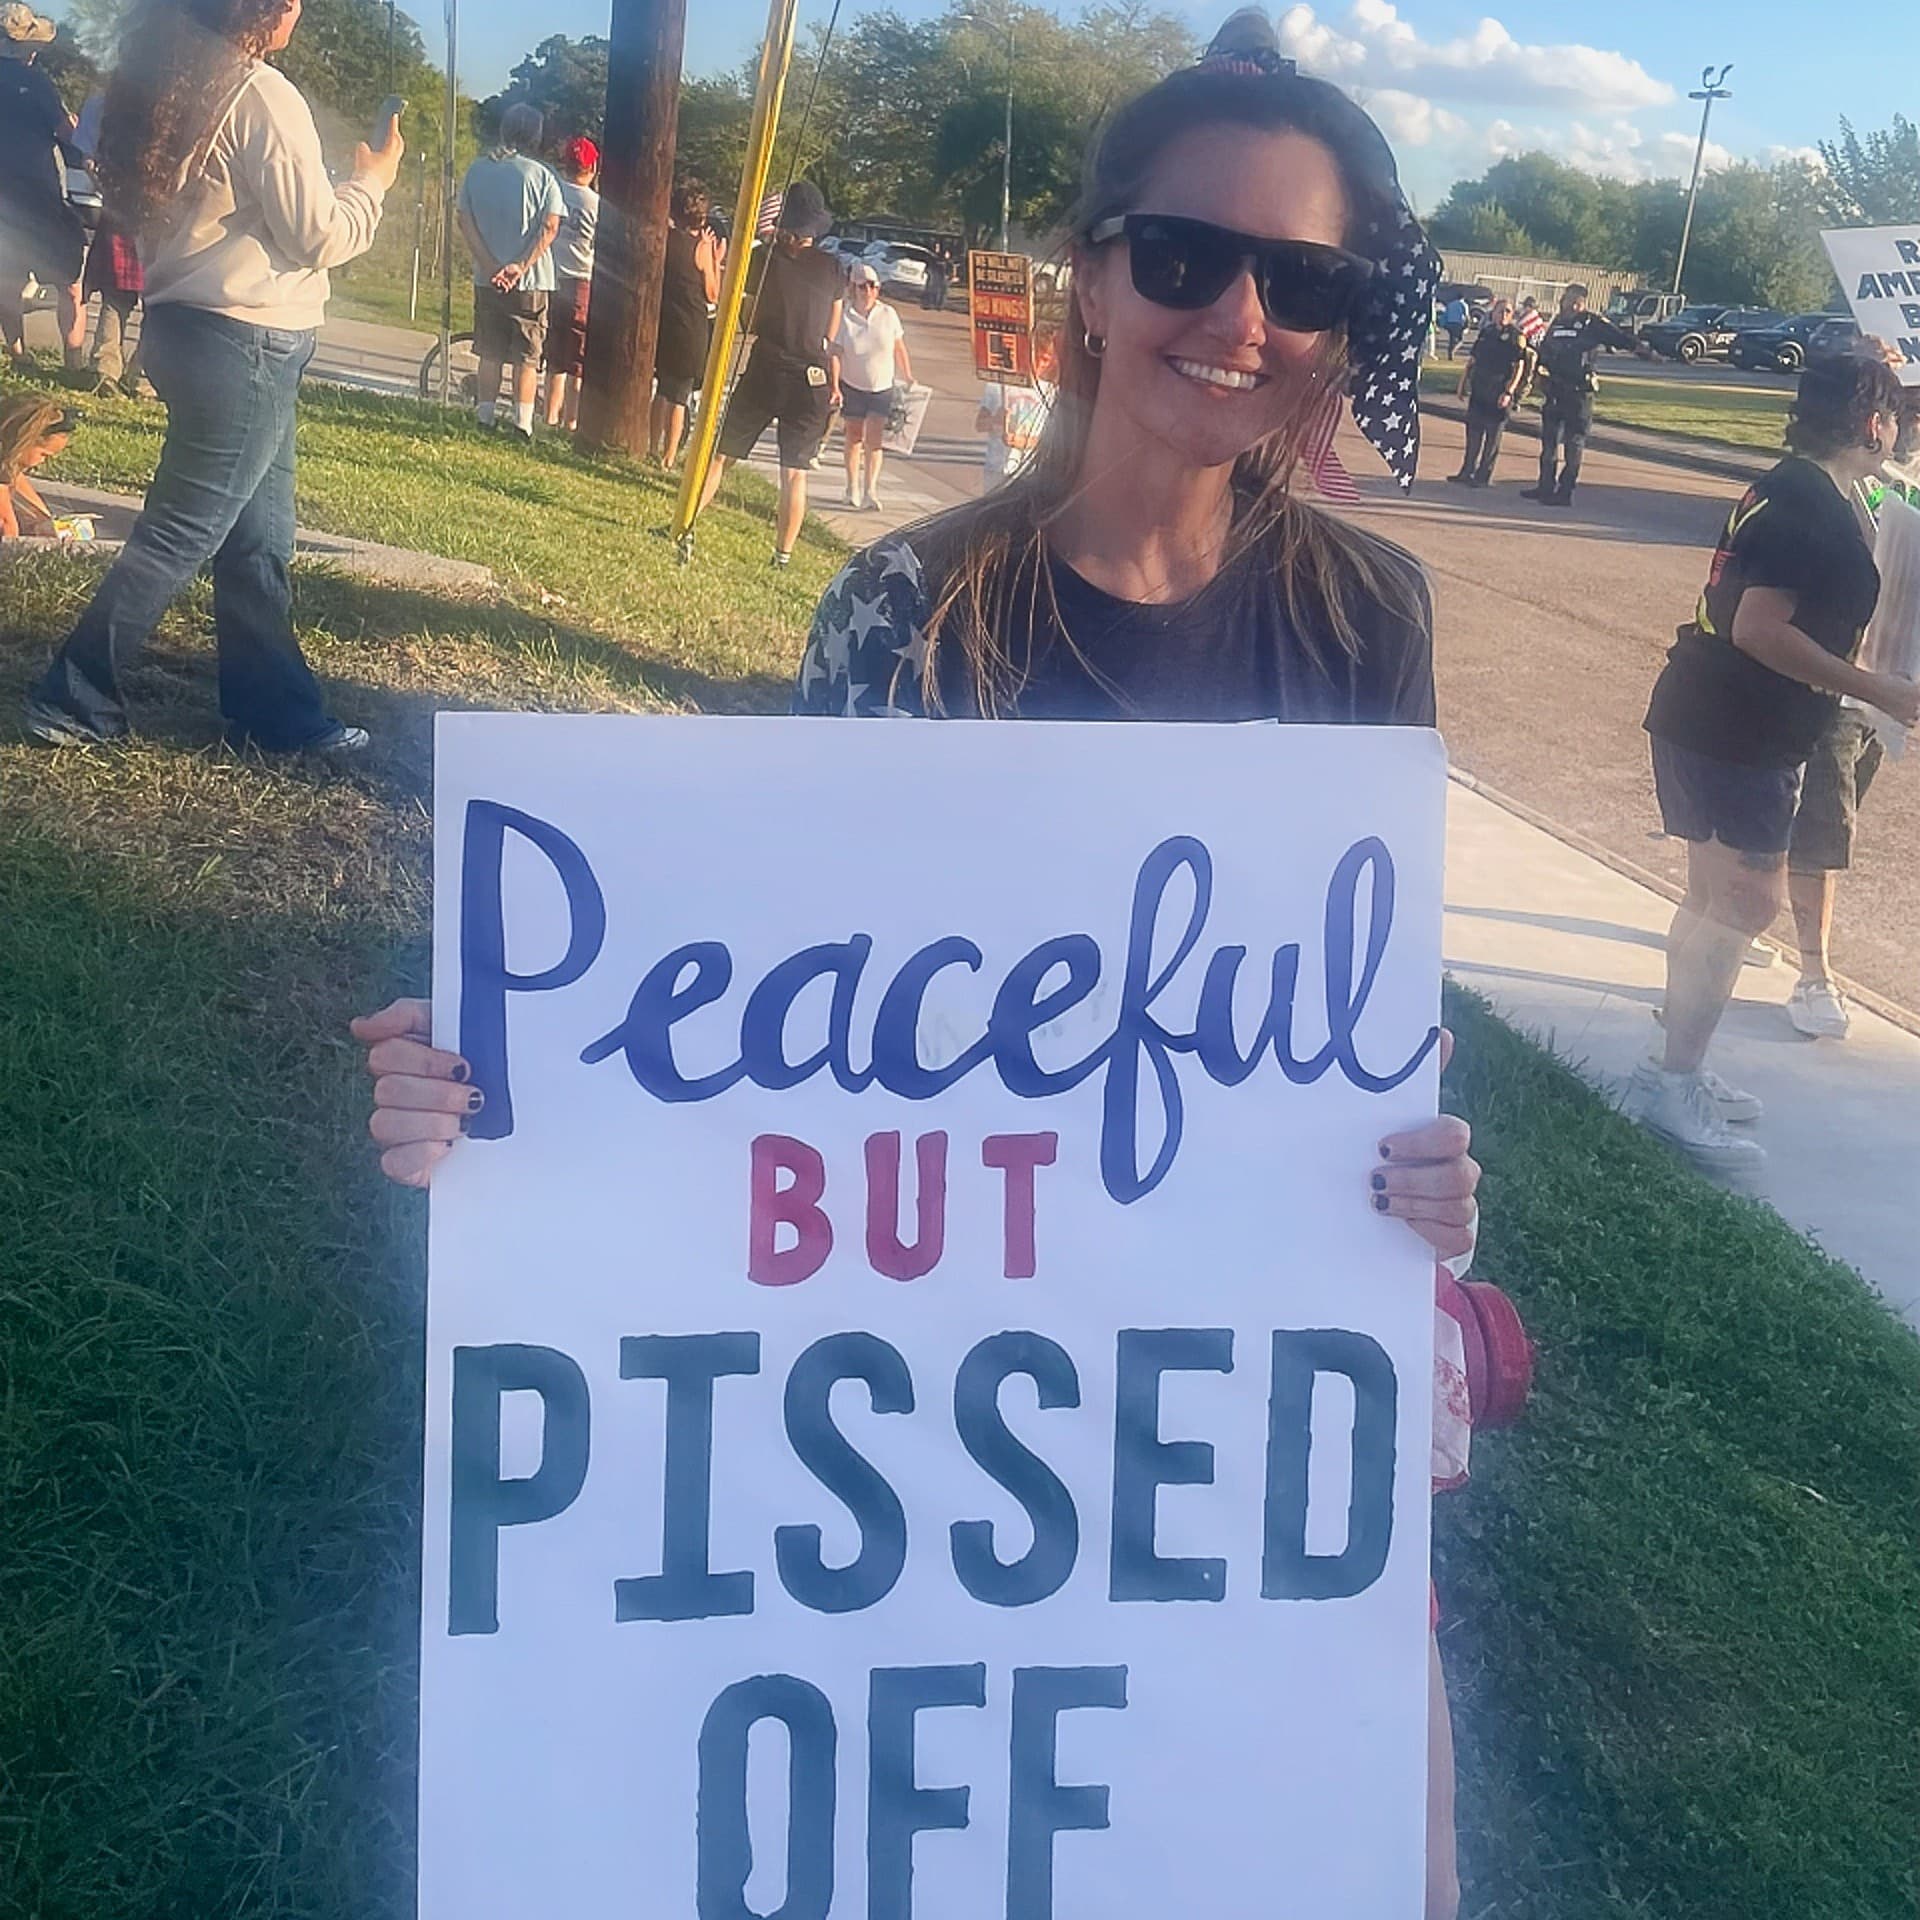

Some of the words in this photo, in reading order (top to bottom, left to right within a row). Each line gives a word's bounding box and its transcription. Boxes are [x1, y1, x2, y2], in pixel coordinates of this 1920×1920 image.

[991, 297, 1026, 319] KINGS
[460, 799, 1440, 1205] Peaceful
[749, 1130, 1059, 1287] BUT
[448, 1328, 1398, 1637] PISSED
[696, 1662, 1129, 1920] OFF
